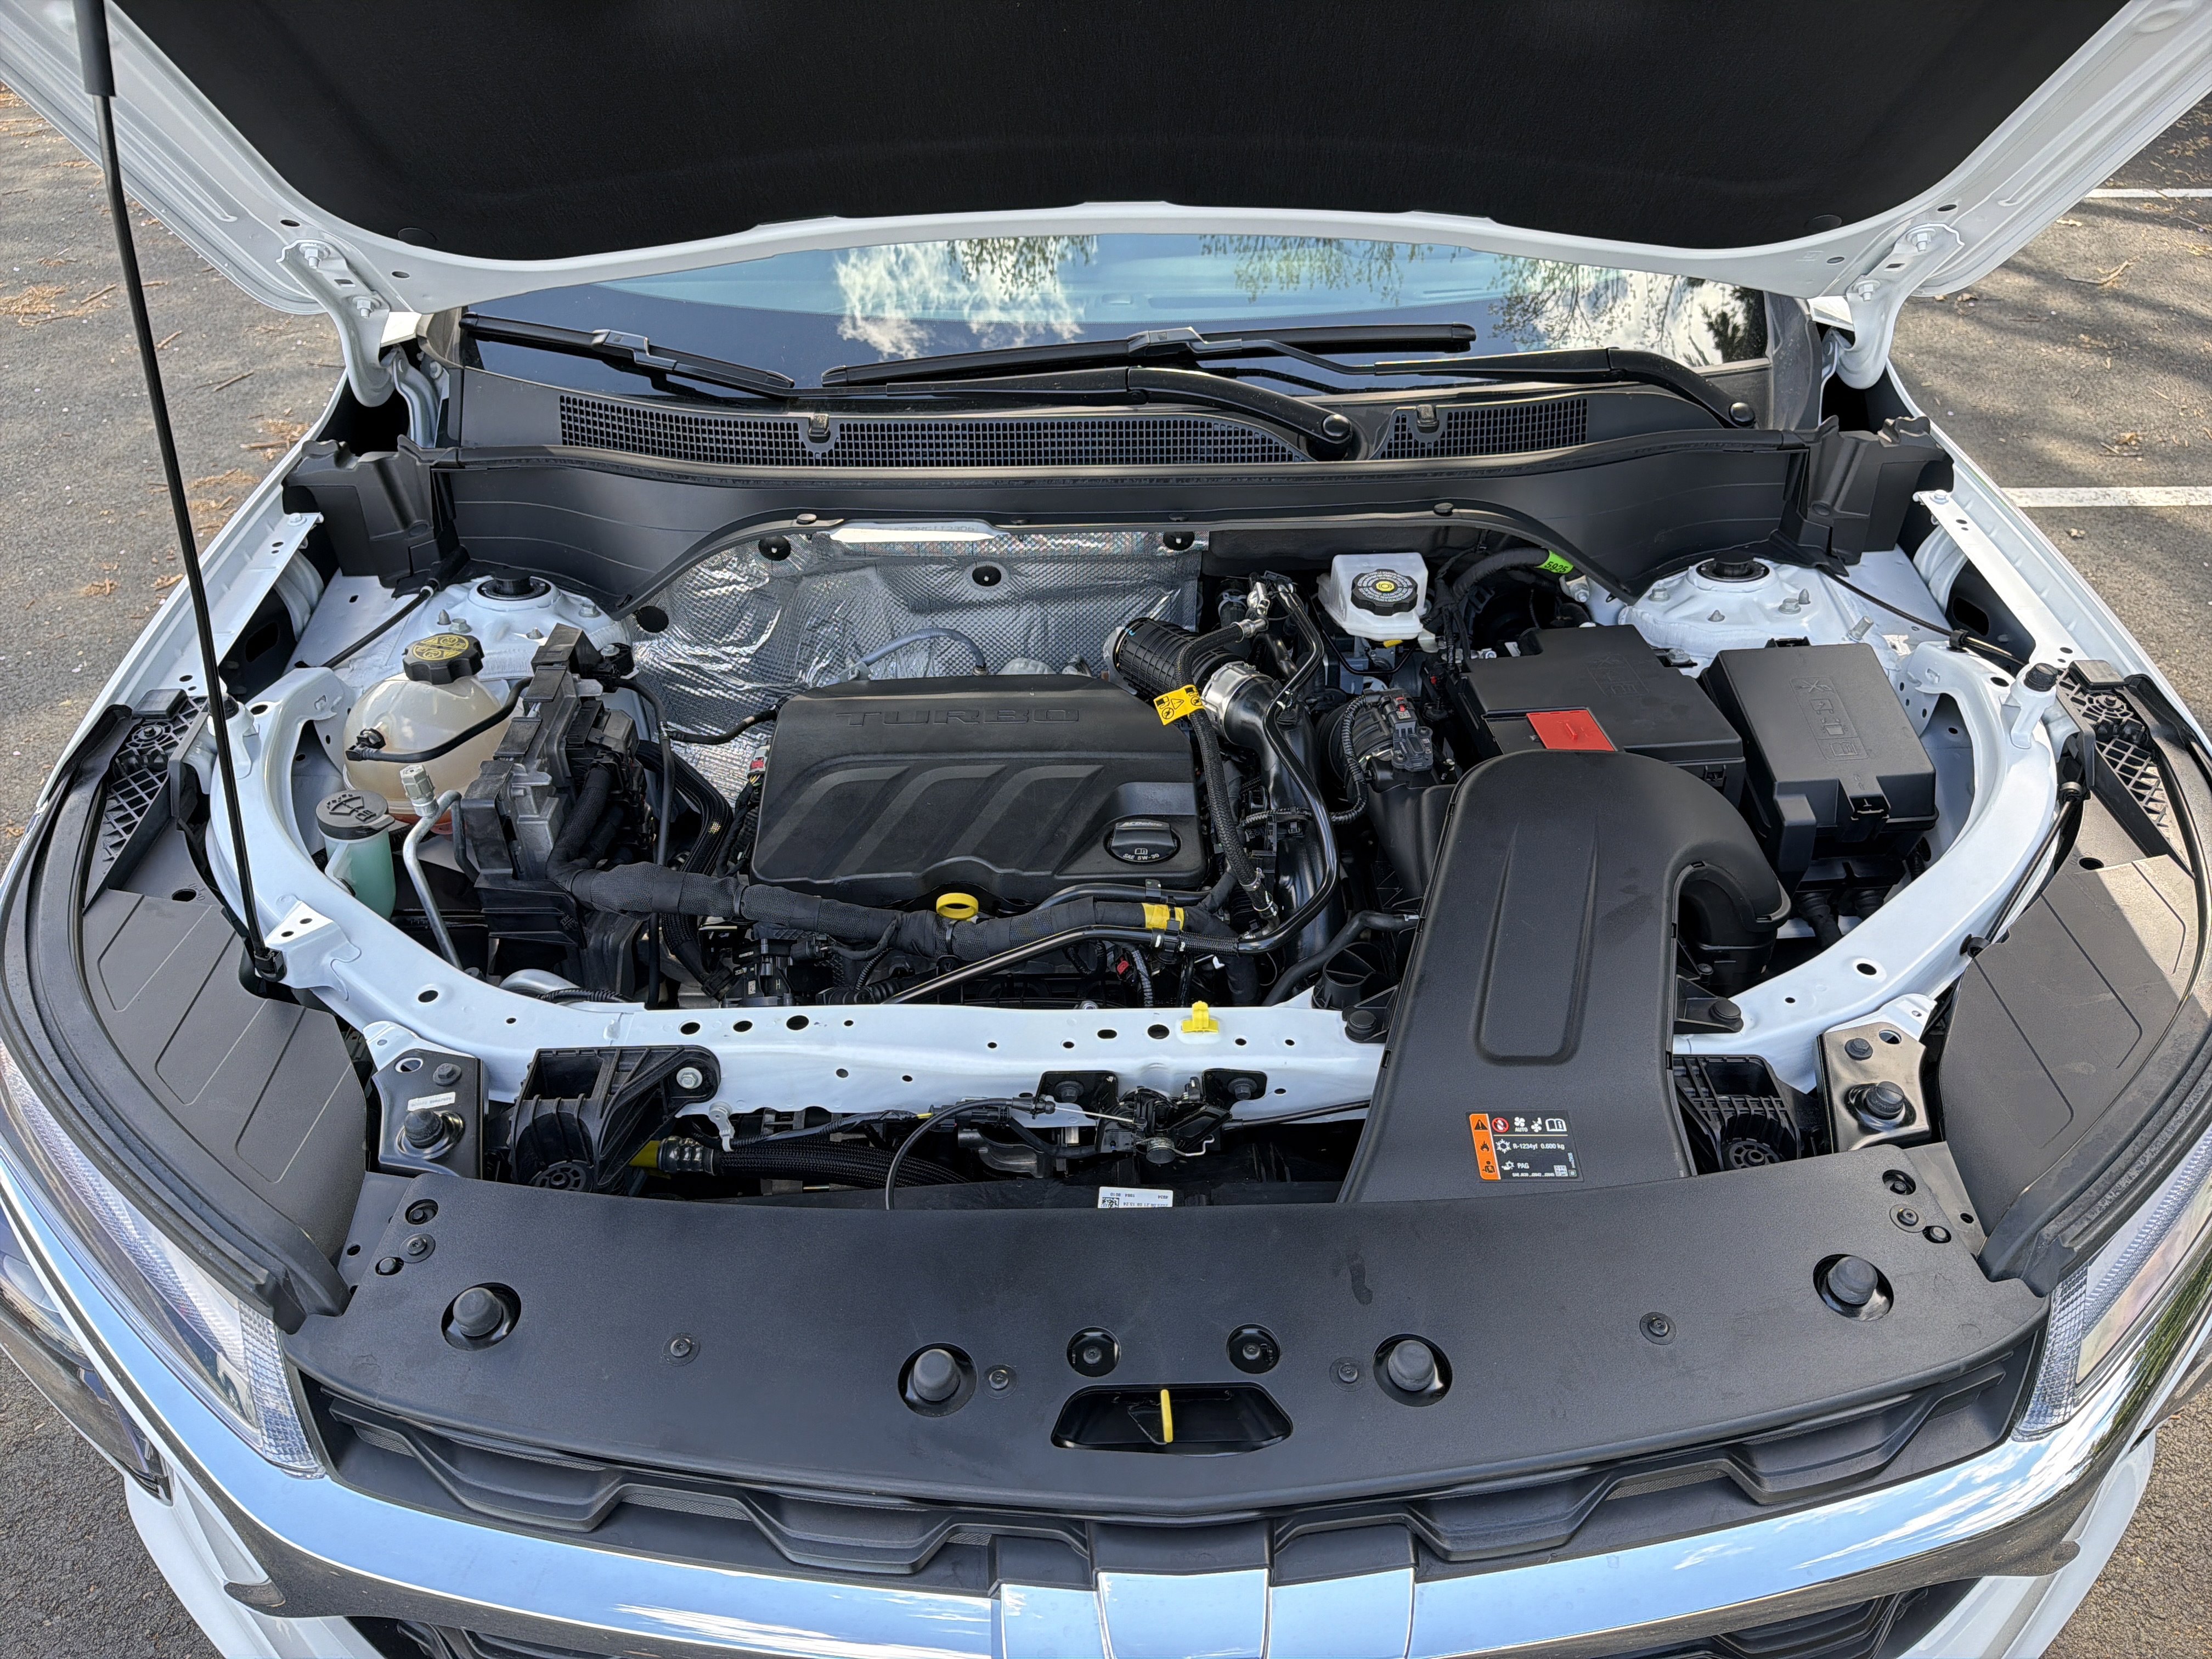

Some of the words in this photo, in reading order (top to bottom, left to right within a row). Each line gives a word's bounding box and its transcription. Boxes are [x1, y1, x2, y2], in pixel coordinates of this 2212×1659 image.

[1544, 561, 1569, 573] 5925
[836, 709, 1079, 727] TURBO
[776, 978, 781, 990] H
